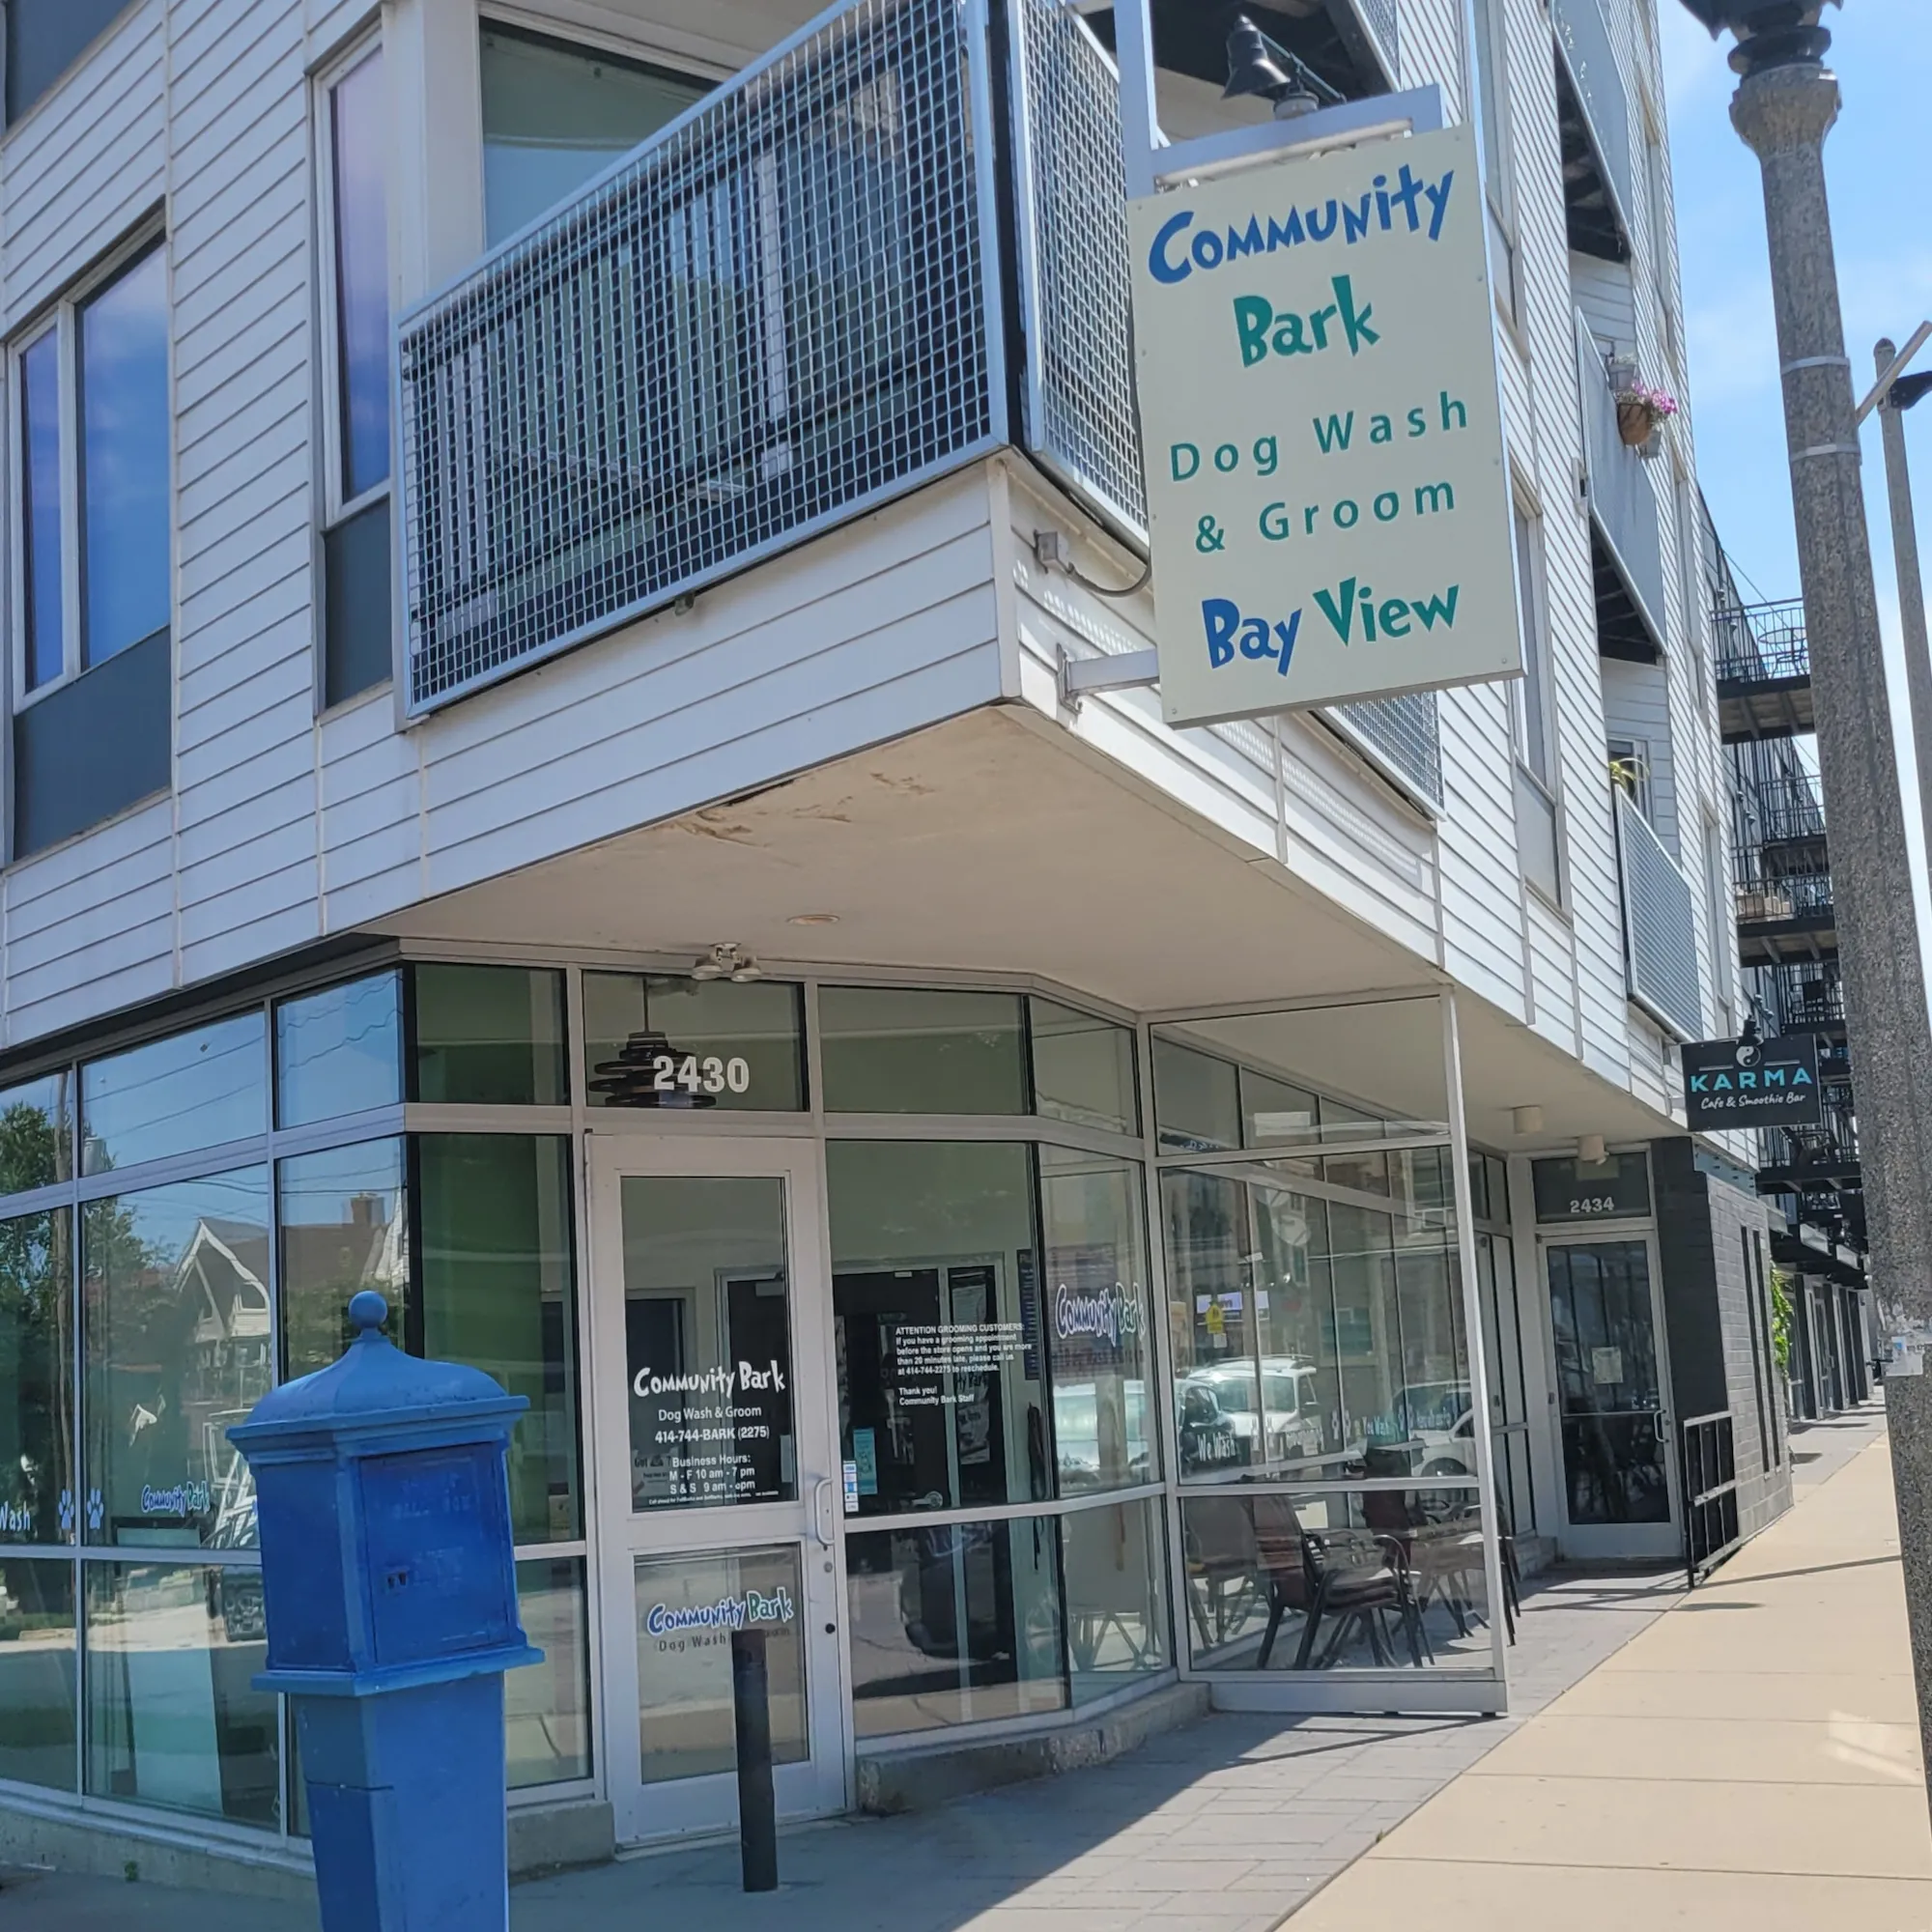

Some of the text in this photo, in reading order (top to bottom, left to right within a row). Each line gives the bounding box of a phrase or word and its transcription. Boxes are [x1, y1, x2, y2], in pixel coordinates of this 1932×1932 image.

[1233, 273, 1380, 368] Bark
[1170, 391, 1468, 481] Dog Wash
[1194, 481, 1456, 554] & Groom
[1201, 576, 1461, 677] Bay View
[653, 1055, 750, 1094] 2430
[1690, 1067, 1813, 1093] KARMA
[1700, 1092, 1806, 1110] Cafe & Smoothie Bar
[1570, 1197, 1614, 1213] 2434
[895, 1325, 936, 1335] ATTENTION
[937, 1324, 978, 1334] GROOMING
[895, 1337, 901, 1346] If
[902, 1338, 916, 1347] you
[917, 1335, 934, 1345] have
[941, 1335, 974, 1346] grooming
[896, 1346, 920, 1355] before
[921, 1346, 932, 1354] the
[933, 1345, 951, 1353] store
[952, 1345, 973, 1353] opens
[974, 1344, 987, 1352] and
[988, 1344, 1002, 1353] you
[897, 1356, 913, 1366] than
[914, 1356, 923, 1365] 20
[924, 1355, 952, 1364] minutes
[969, 1354, 991, 1363] please
[738, 1359, 786, 1393] Bark
[897, 1368, 905, 1377] at
[906, 1365, 952, 1375] 414-744-2275
[952, 1365, 960, 1374] to
[898, 1385, 938, 1396] Thank you!
[899, 1393, 975, 1406] Community Bark Staff
[658, 1406, 762, 1424] Dog Wash & Groom
[655, 1425, 770, 1444] 414-744-BARK (2275)
[1198, 1433, 1212, 1462] We
[672, 1453, 752, 1468] Business Hours:
[668, 1470, 677, 1482] M
[687, 1469, 693, 1480] F
[696, 1468, 707, 1479] 10
[709, 1469, 724, 1479] am
[731, 1466, 738, 1476] 7
[740, 1467, 755, 1479] pm
[669, 1484, 677, 1494] S
[679, 1483, 687, 1493] &
[689, 1483, 696, 1493] S
[703, 1482, 710, 1492] 9
[711, 1482, 726, 1492] am
[0, 1500, 30, 1531] Wash
[746, 1586, 795, 1623] Bark
[659, 1639, 686, 1653] Dog
[692, 1633, 726, 1648] Wash
